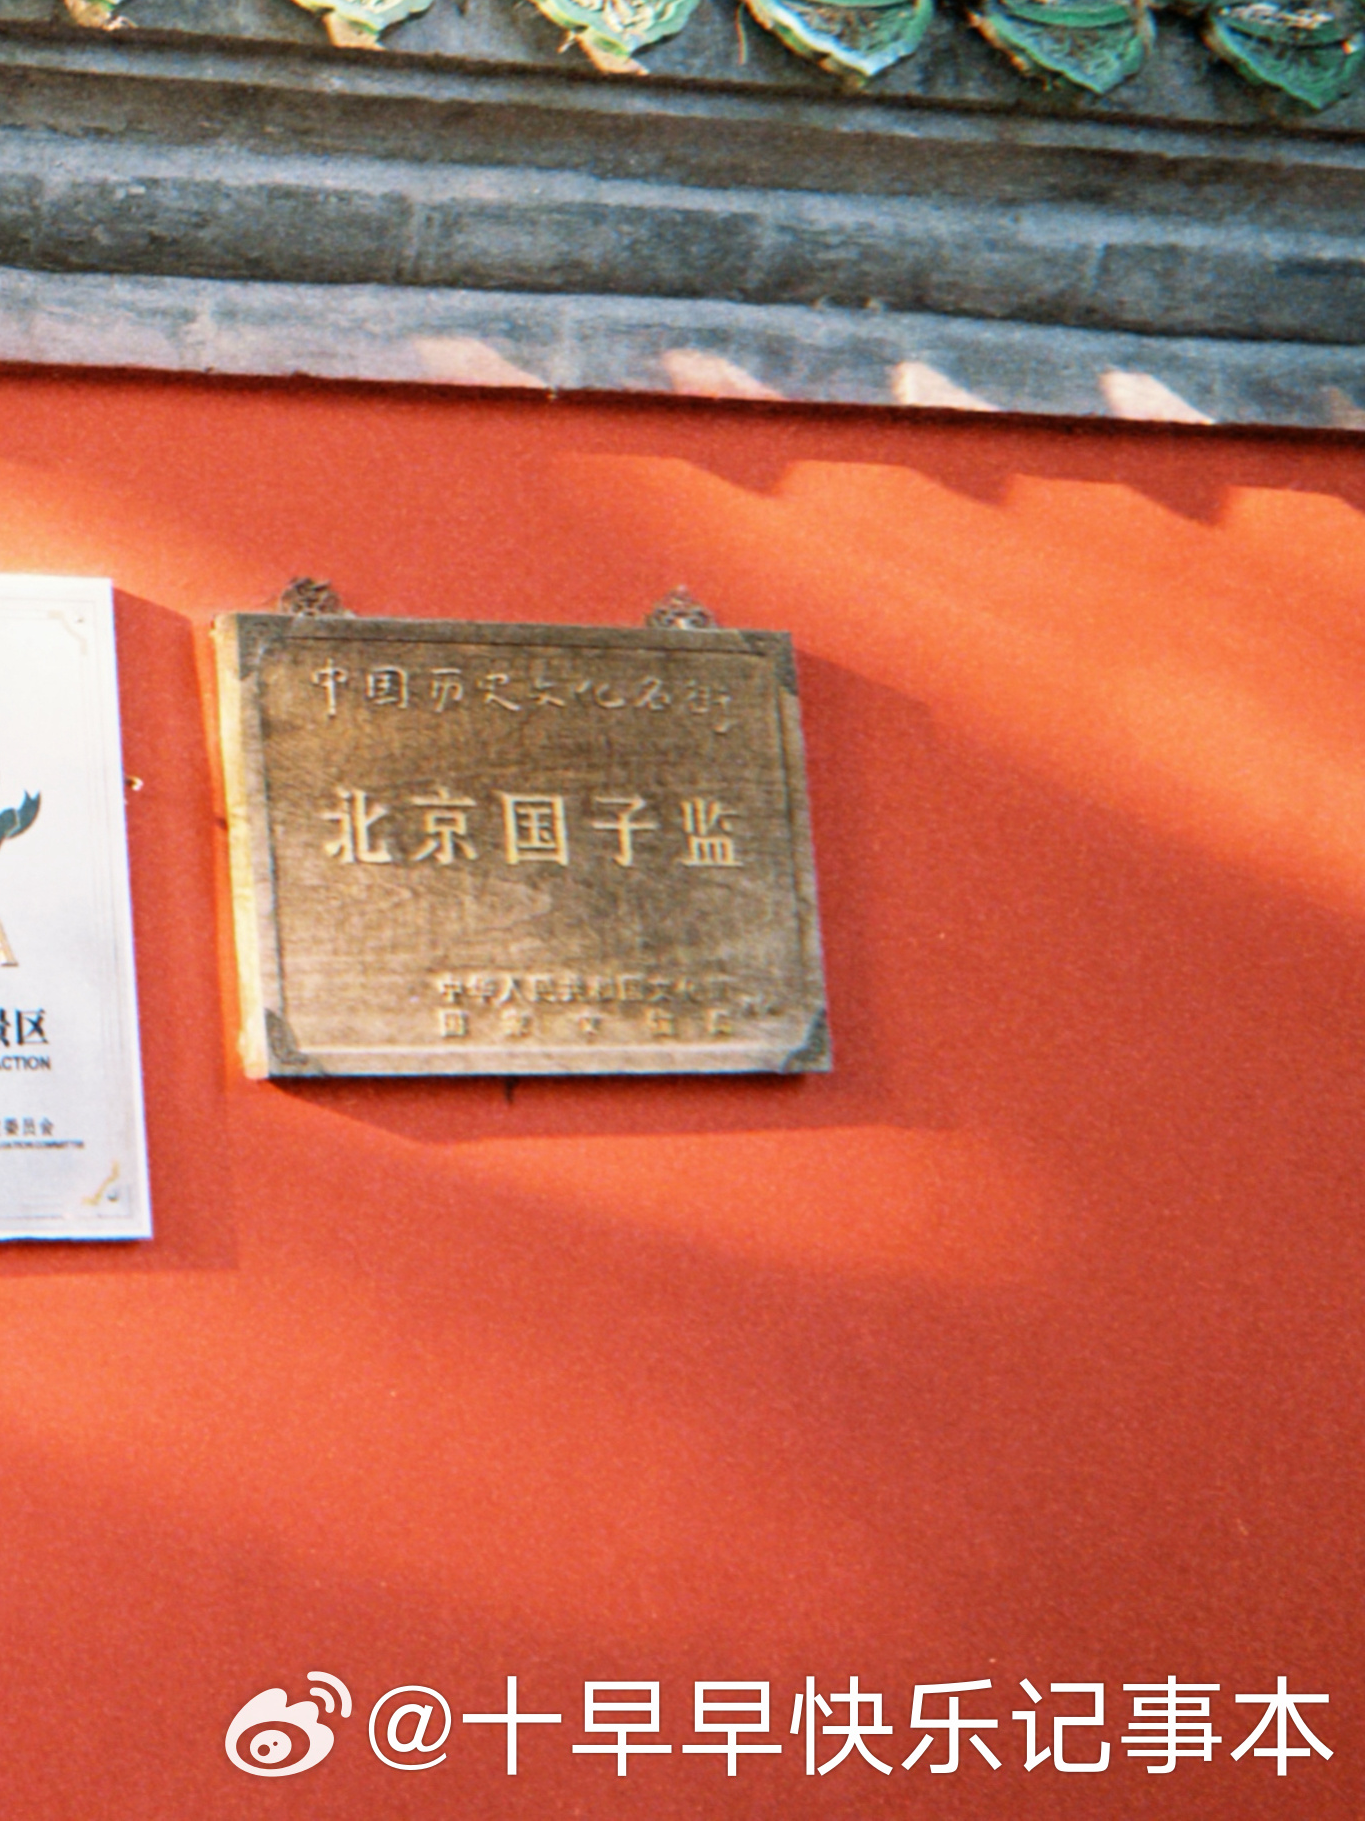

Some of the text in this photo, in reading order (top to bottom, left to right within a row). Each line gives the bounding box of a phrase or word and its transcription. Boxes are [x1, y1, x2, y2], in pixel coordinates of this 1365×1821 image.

[319, 786, 746, 870] 北京国子监
